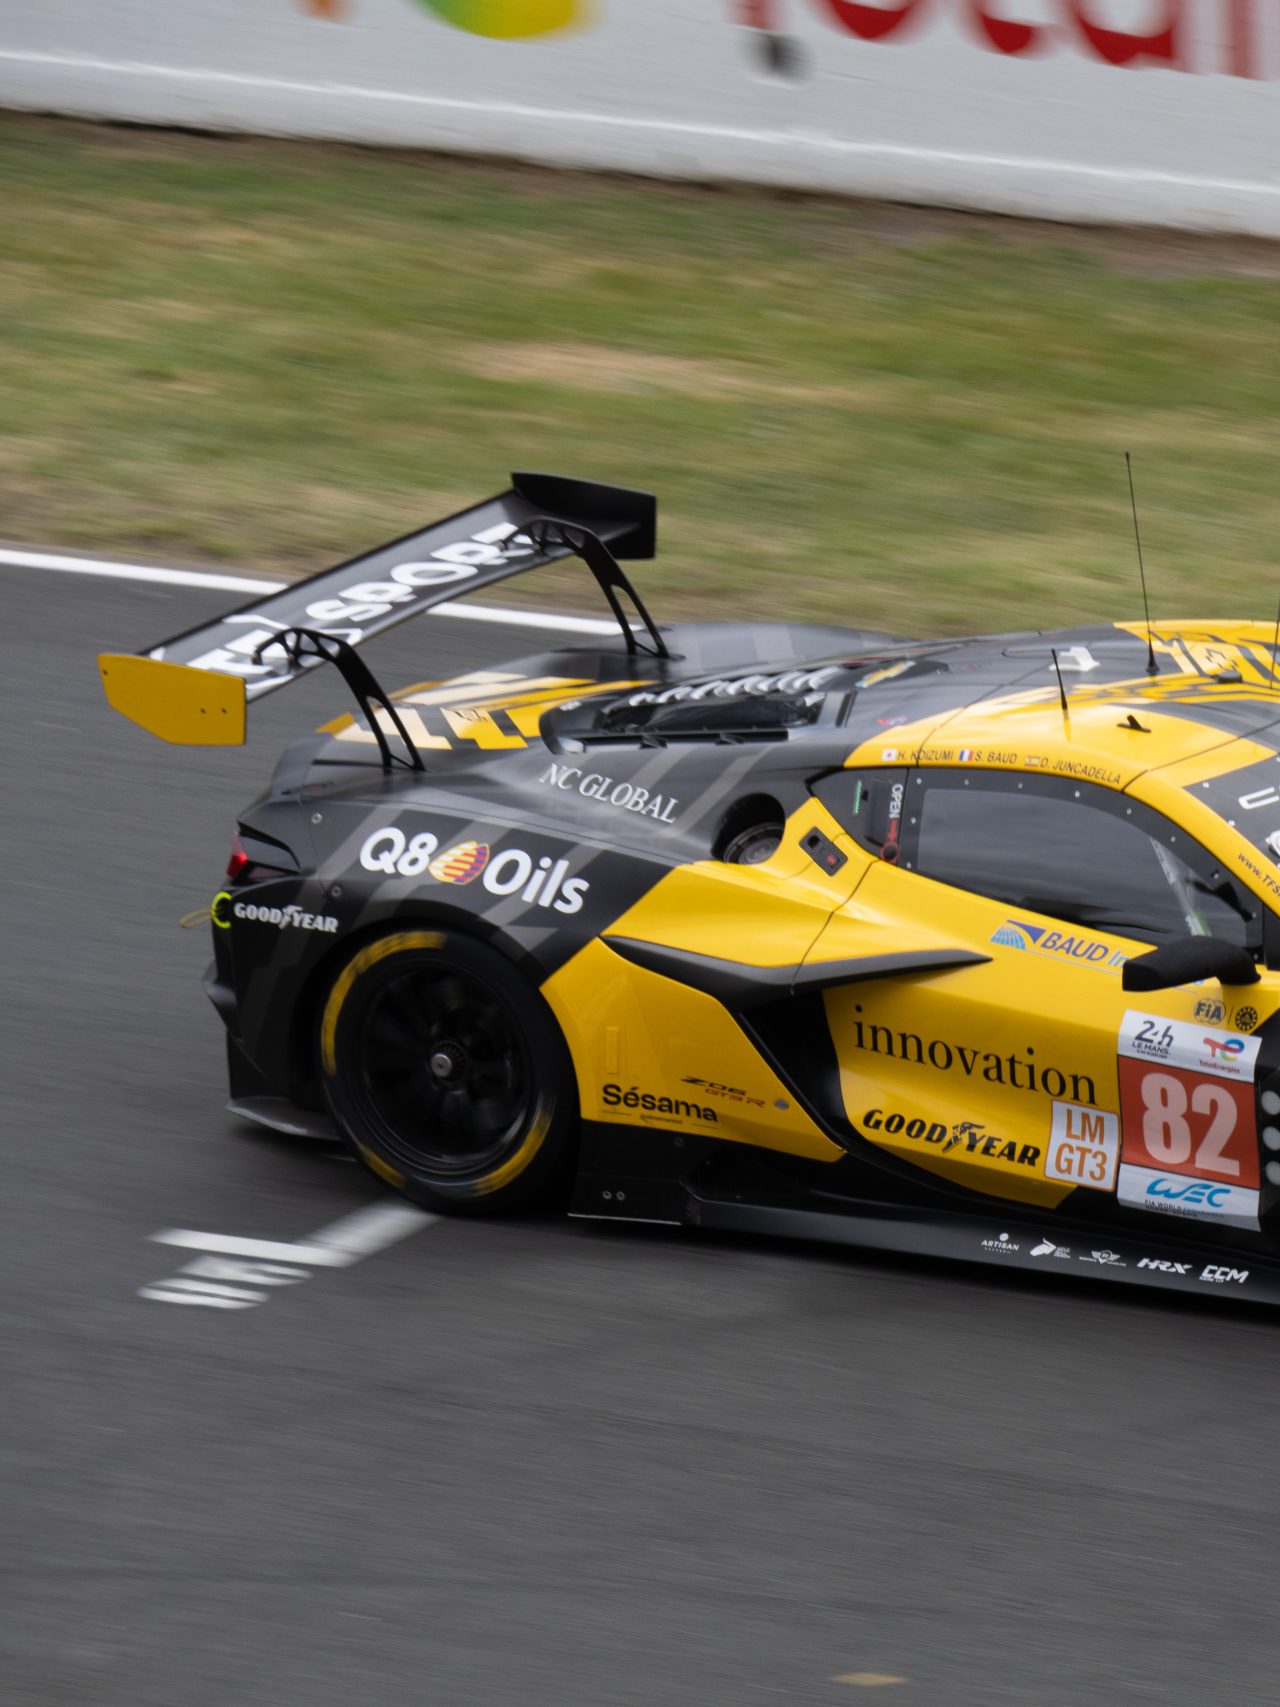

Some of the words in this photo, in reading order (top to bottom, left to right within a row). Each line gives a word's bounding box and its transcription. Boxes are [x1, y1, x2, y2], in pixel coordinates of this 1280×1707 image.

[987, 751, 1018, 764] BAUD
[1040, 756, 1049, 768] D.
[1053, 759, 1122, 784] JUNCADELLA
[538, 762, 580, 791] NC
[579, 774, 678, 824] GLOBAL
[888, 783, 904, 819] OPEN
[359, 826, 438, 876] Q8
[482, 848, 590, 914] Oils
[233, 901, 339, 934] GOODYEAR
[1040, 931, 1110, 962] BAUD
[853, 1004, 1099, 1106] innovation
[1131, 1041, 1143, 1050] LE
[1144, 1043, 1169, 1055] MANS
[1198, 1060, 1241, 1074] TotalEnergies
[602, 1083, 719, 1123] Sésama
[862, 1109, 1041, 1167] GOODYEAR
[1066, 1108, 1105, 1145] LM
[1140, 1072, 1240, 1177] 82
[1055, 1142, 1108, 1181] GT3
[1146, 1177, 1232, 1208] WEC
[981, 1239, 1019, 1251] ARTISAN
[1136, 1257, 1193, 1274] HRX
